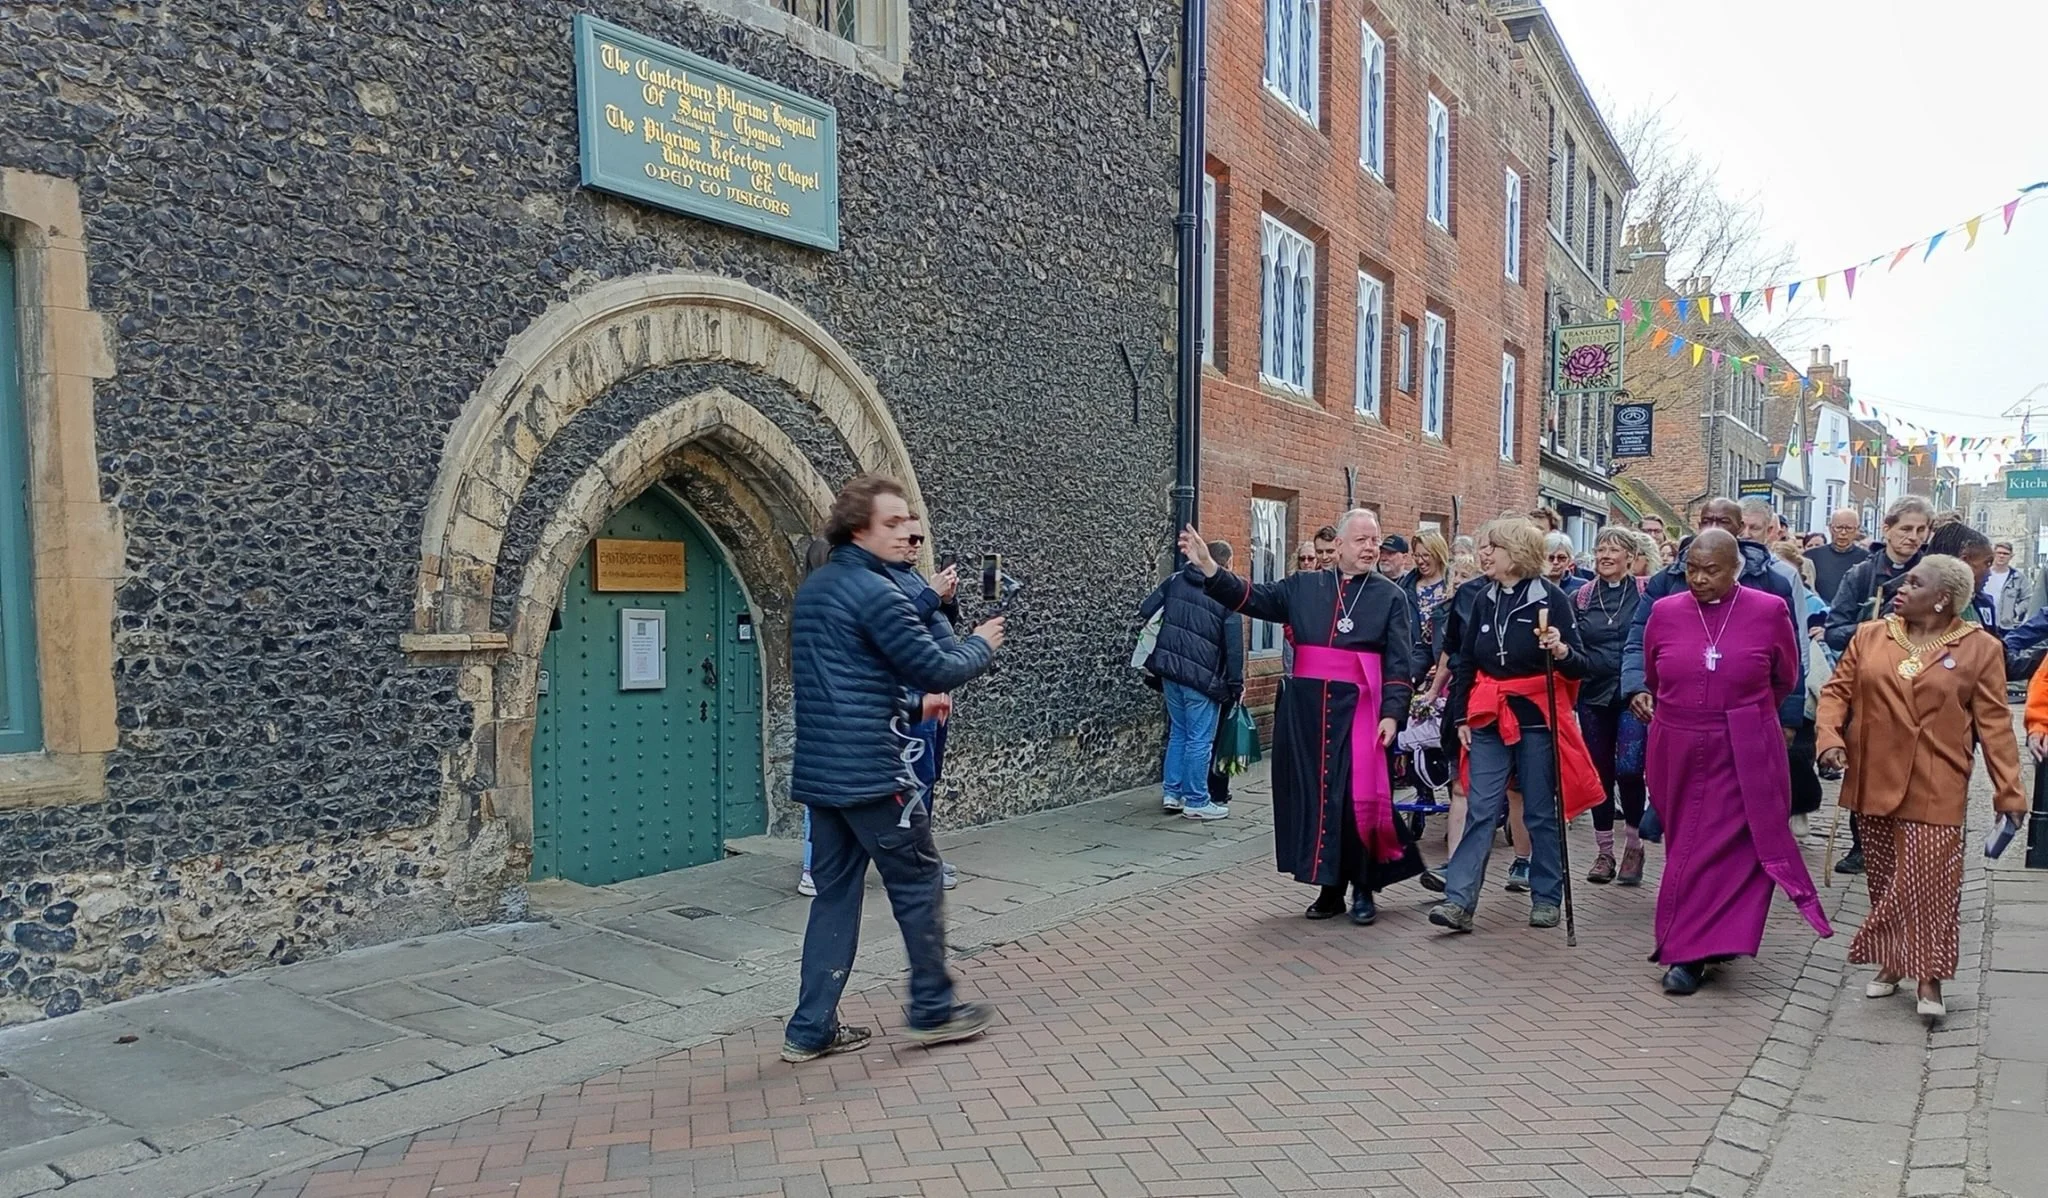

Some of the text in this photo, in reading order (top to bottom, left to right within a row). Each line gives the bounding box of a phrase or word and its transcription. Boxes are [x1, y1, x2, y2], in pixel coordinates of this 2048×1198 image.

[600, 44, 817, 140] The Canterbury Pilgrims Hospital
[643, 83, 667, 108] Of
[678, 95, 717, 126] Saint
[733, 113, 785, 150] Thomas.
[605, 103, 635, 135] The
[642, 116, 701, 154] Pilgrims
[778, 162, 820, 193] Chapel
[662, 145, 731, 183] Undercroft
[751, 174, 777, 196] Etc.
[645, 163, 694, 189] OPEN
[699, 180, 721, 197] TO
[1563, 327, 1616, 338] FRANCISCAN
[1567, 334, 1616, 345] GARDENS
